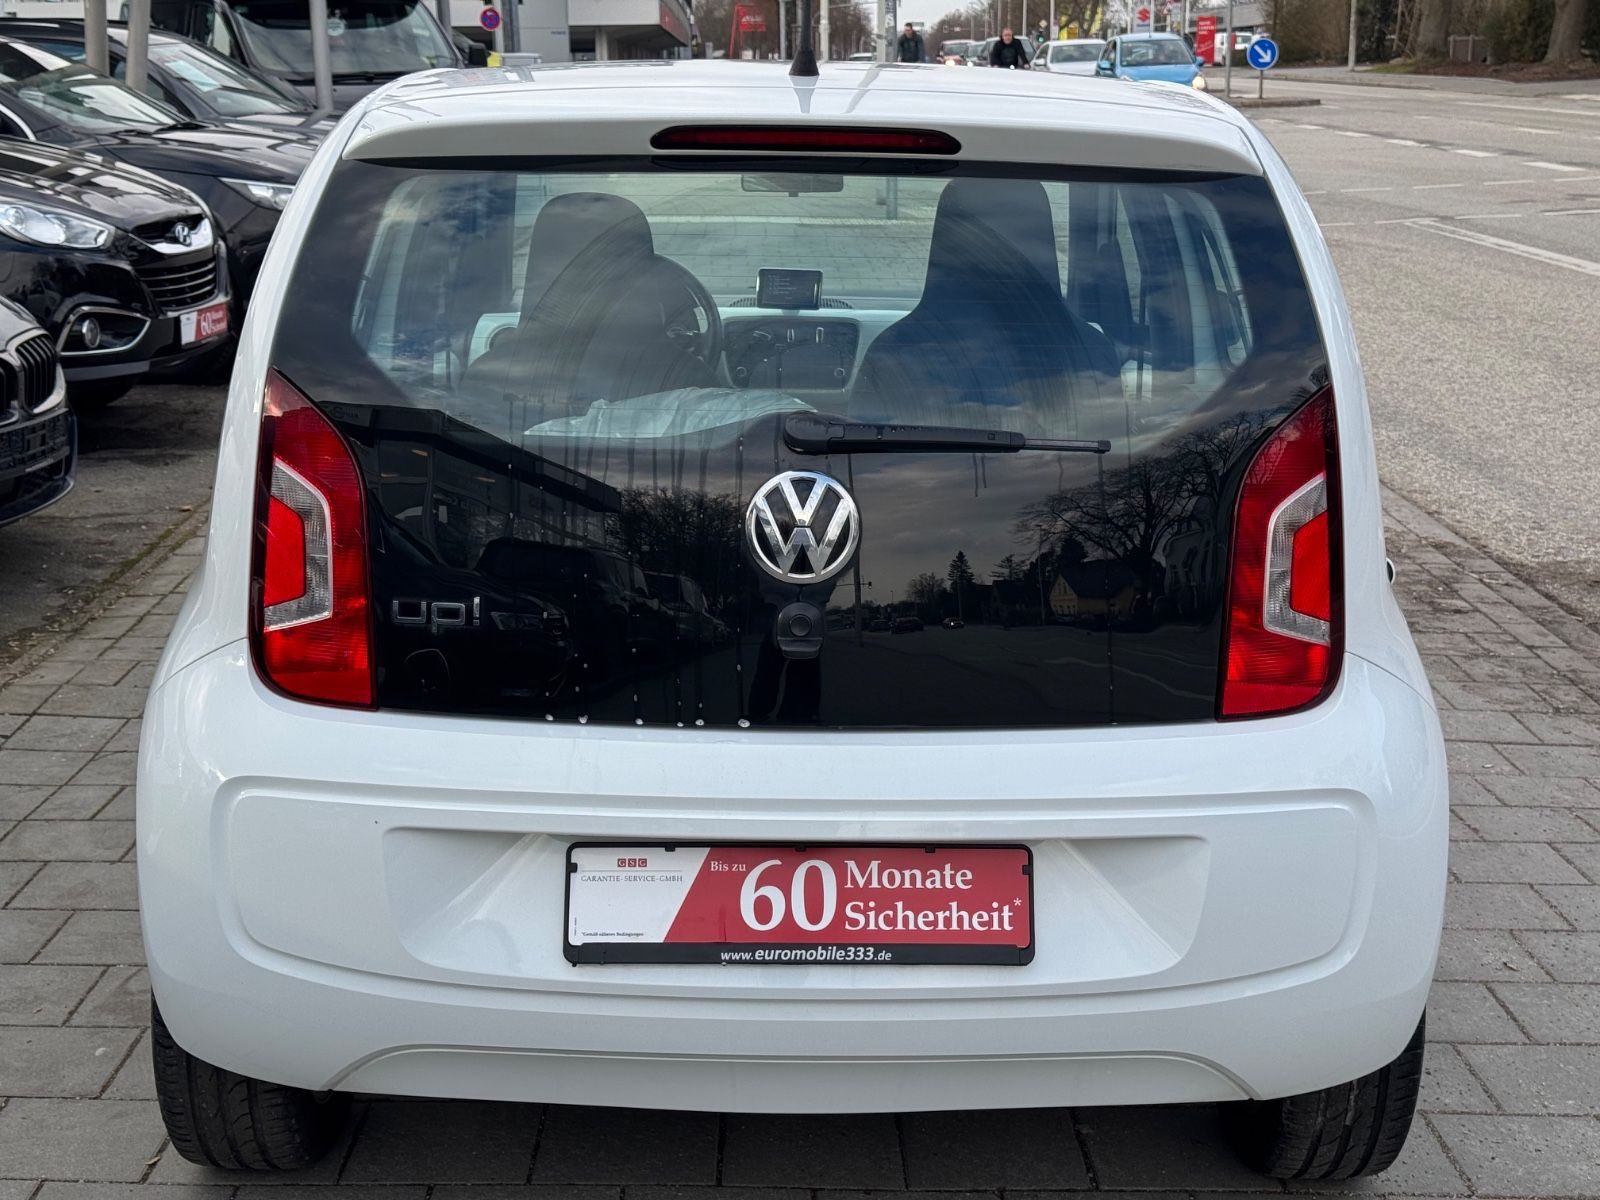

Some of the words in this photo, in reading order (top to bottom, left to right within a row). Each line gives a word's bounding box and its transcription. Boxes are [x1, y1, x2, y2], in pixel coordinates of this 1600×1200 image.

[201, 312, 212, 335] 60
[745, 471, 860, 584] VW
[392, 596, 481, 633] up!
[617, 858, 647, 868] GSG
[710, 861, 729, 871] Bis
[732, 863, 746, 871] zu
[844, 860, 973, 890] Monate
[740, 859, 837, 931] 60
[720, 946, 892, 961] www.euromobile333.de
